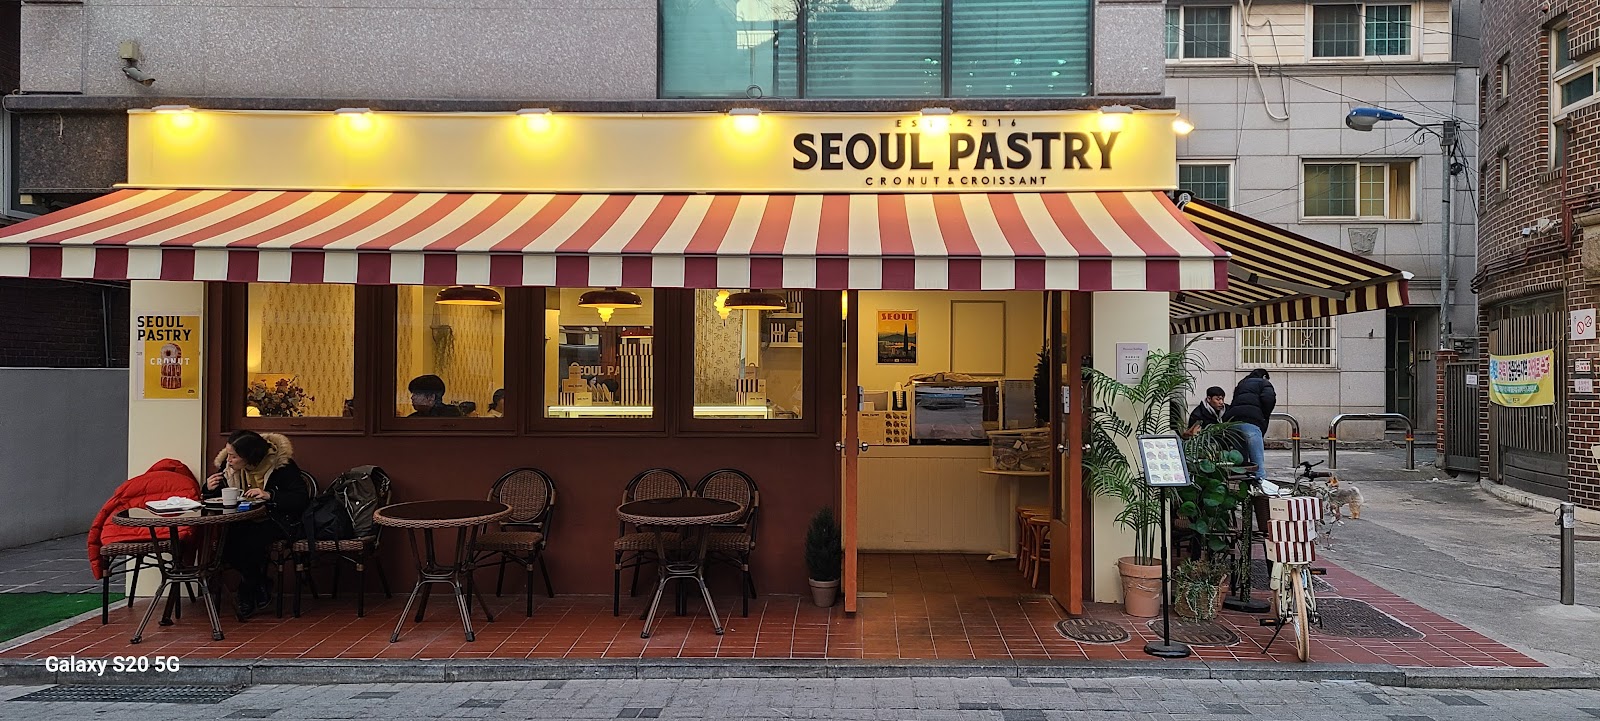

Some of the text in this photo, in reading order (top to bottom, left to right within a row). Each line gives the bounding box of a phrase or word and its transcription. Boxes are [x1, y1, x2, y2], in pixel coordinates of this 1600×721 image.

[966, 118, 1017, 128] 2016
[793, 131, 1121, 171] SEOUL PASTRY
[865, 176, 1047, 186] CRONUT & CROISSANT
[137, 315, 184, 328] SEOUL
[881, 313, 915, 321] SEOUL
[137, 329, 192, 341] PASTRY
[150, 357, 190, 366] CRONUT
[580, 365, 604, 376] EOUL
[1126, 363, 1139, 375] 10
